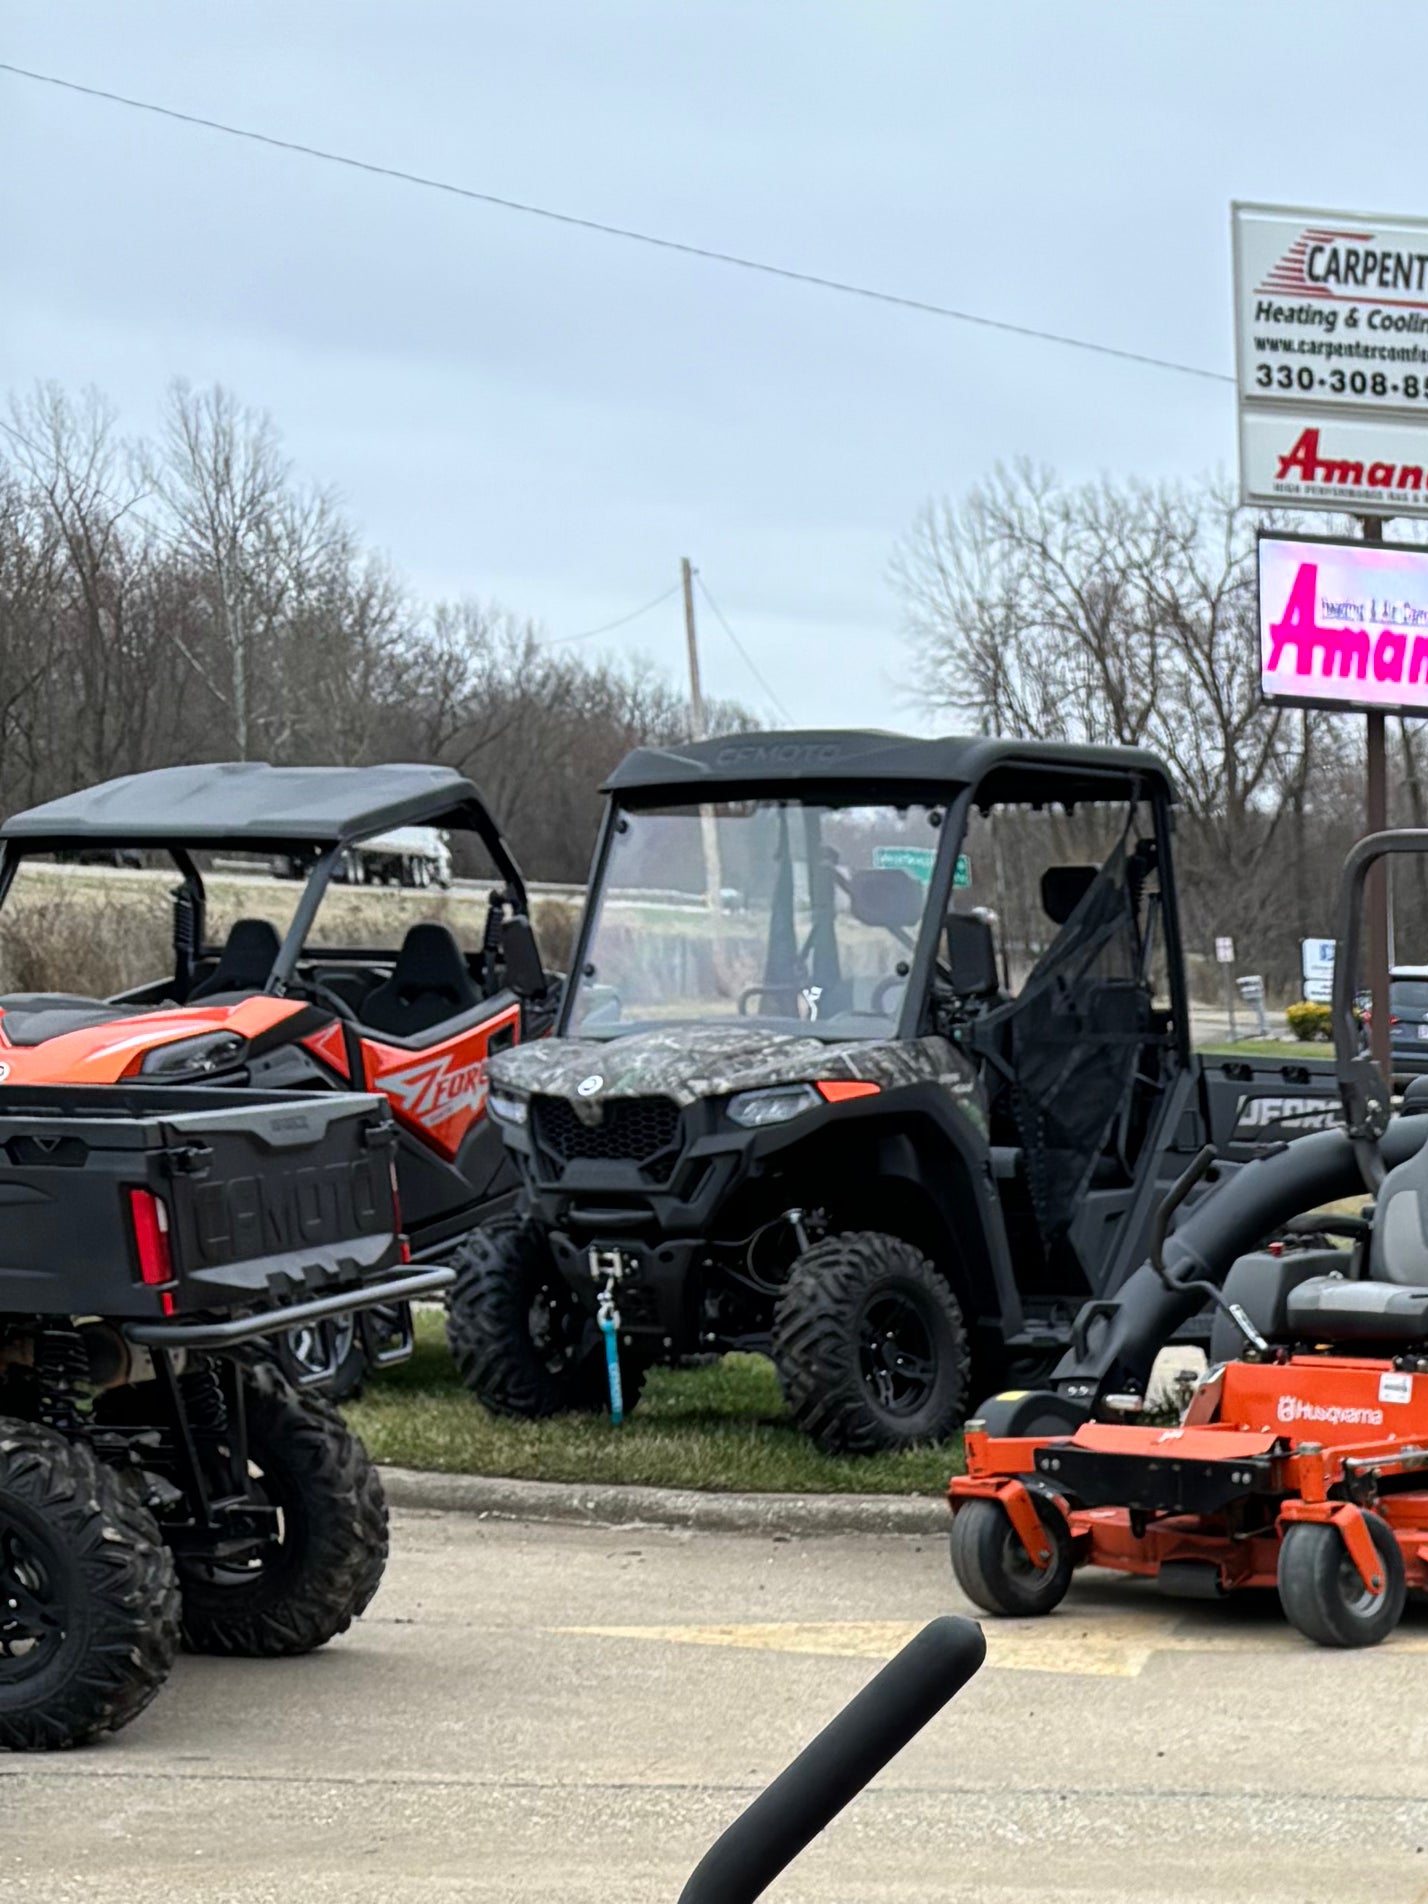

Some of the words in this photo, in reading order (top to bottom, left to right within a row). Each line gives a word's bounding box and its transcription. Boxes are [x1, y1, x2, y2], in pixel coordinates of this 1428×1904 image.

[1255, 301, 1337, 332] Heating
[1345, 306, 1359, 328] &
[1295, 1399, 1384, 1426] Husqvarna
